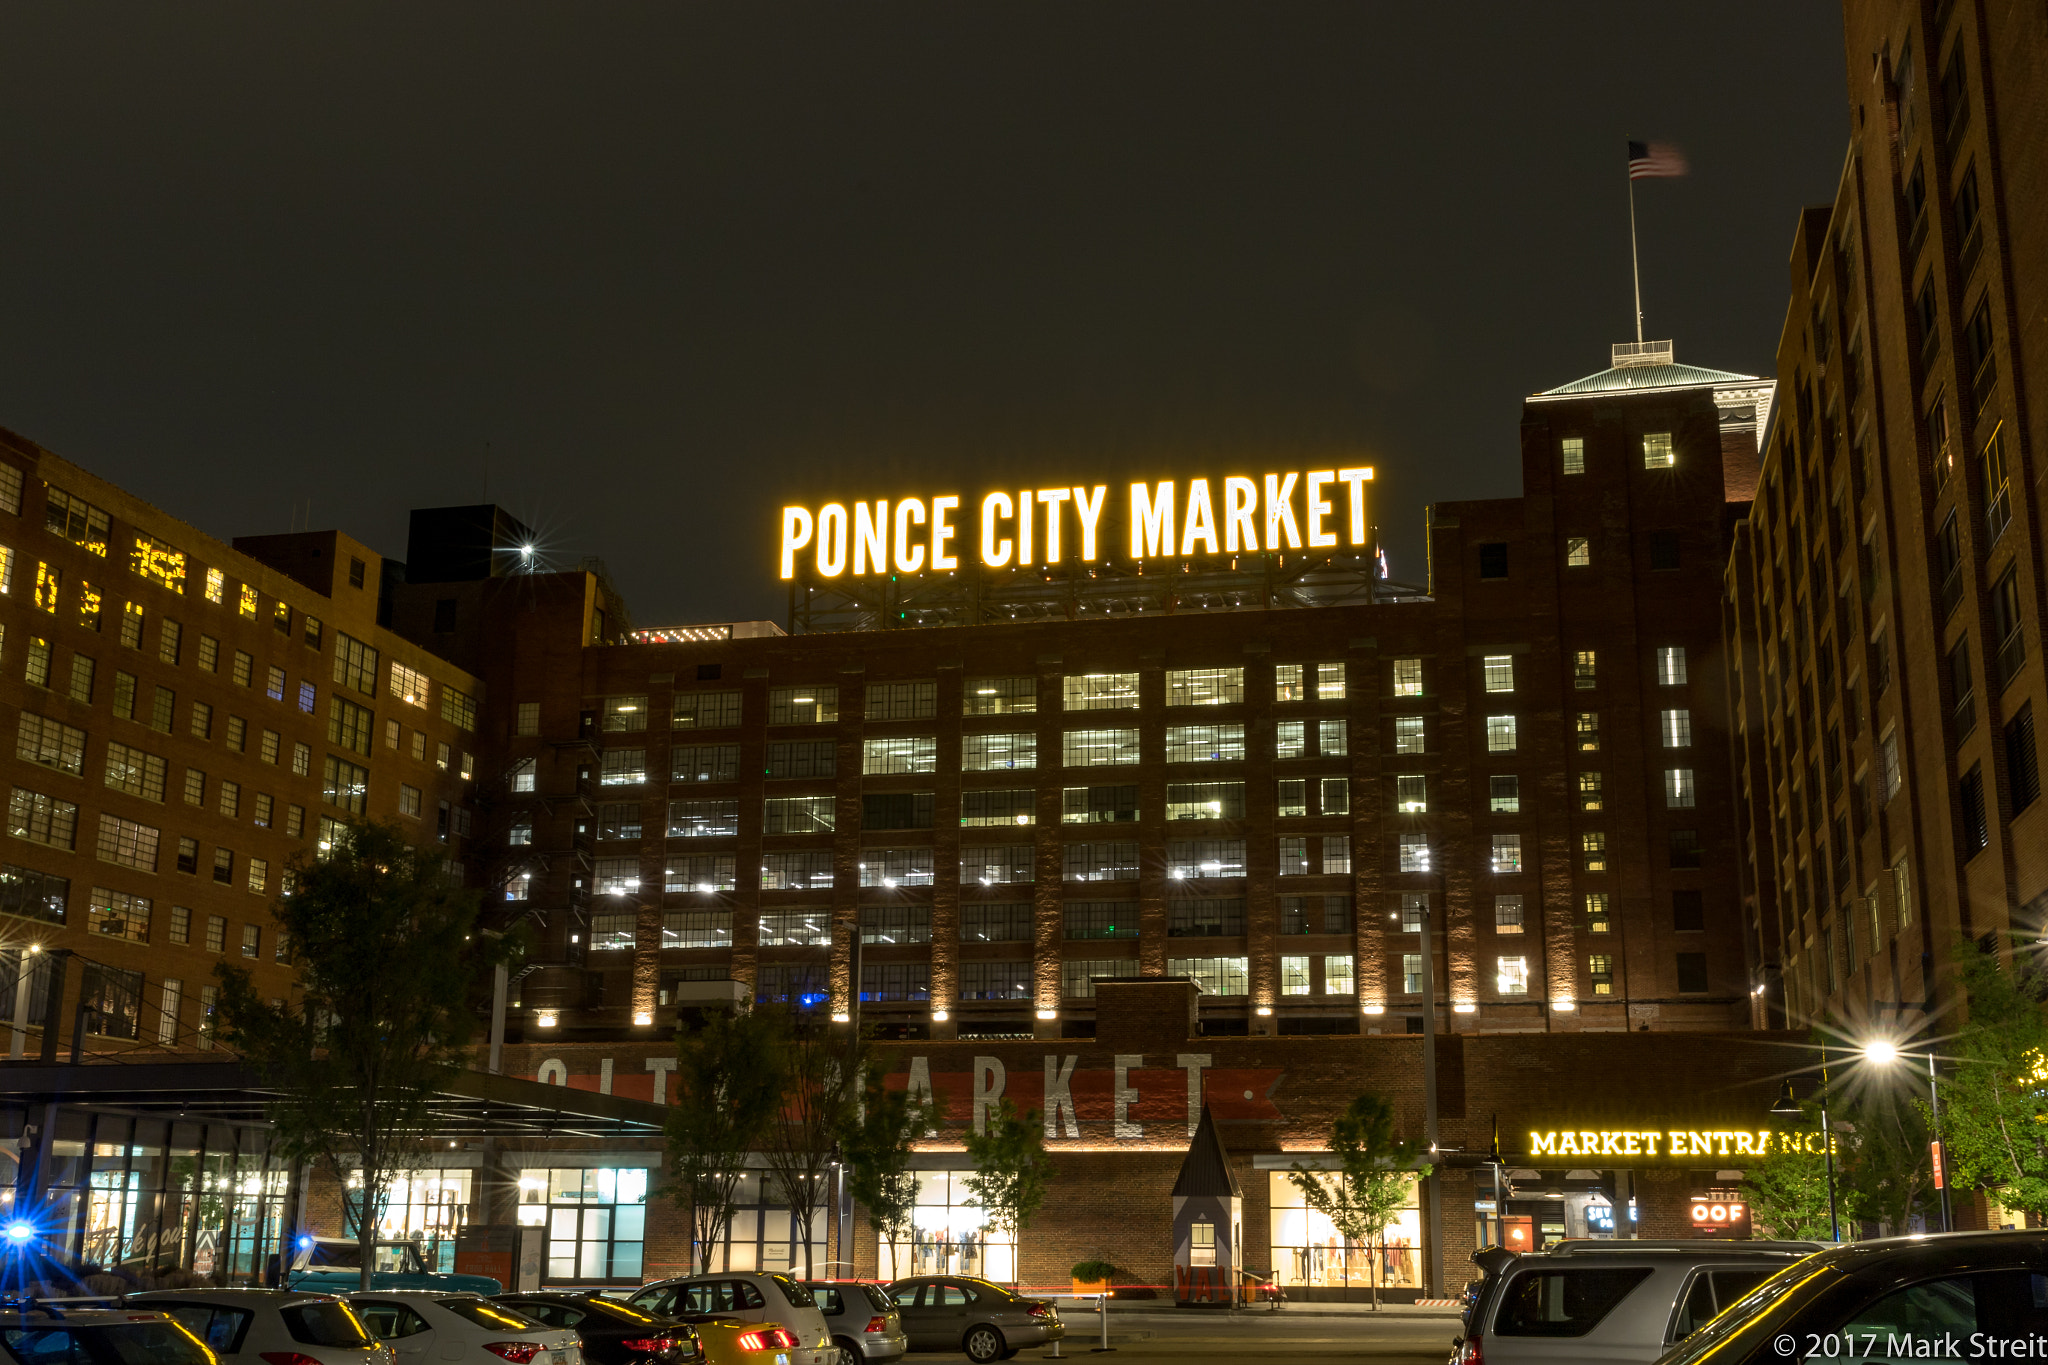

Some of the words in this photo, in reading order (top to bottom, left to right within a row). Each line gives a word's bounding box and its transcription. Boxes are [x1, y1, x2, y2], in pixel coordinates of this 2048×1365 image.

[781, 496, 959, 580] PONCE
[981, 486, 1107, 567] CITY
[1130, 466, 1375, 559] MARKET
[1530, 1131, 1661, 1155] MARKET
